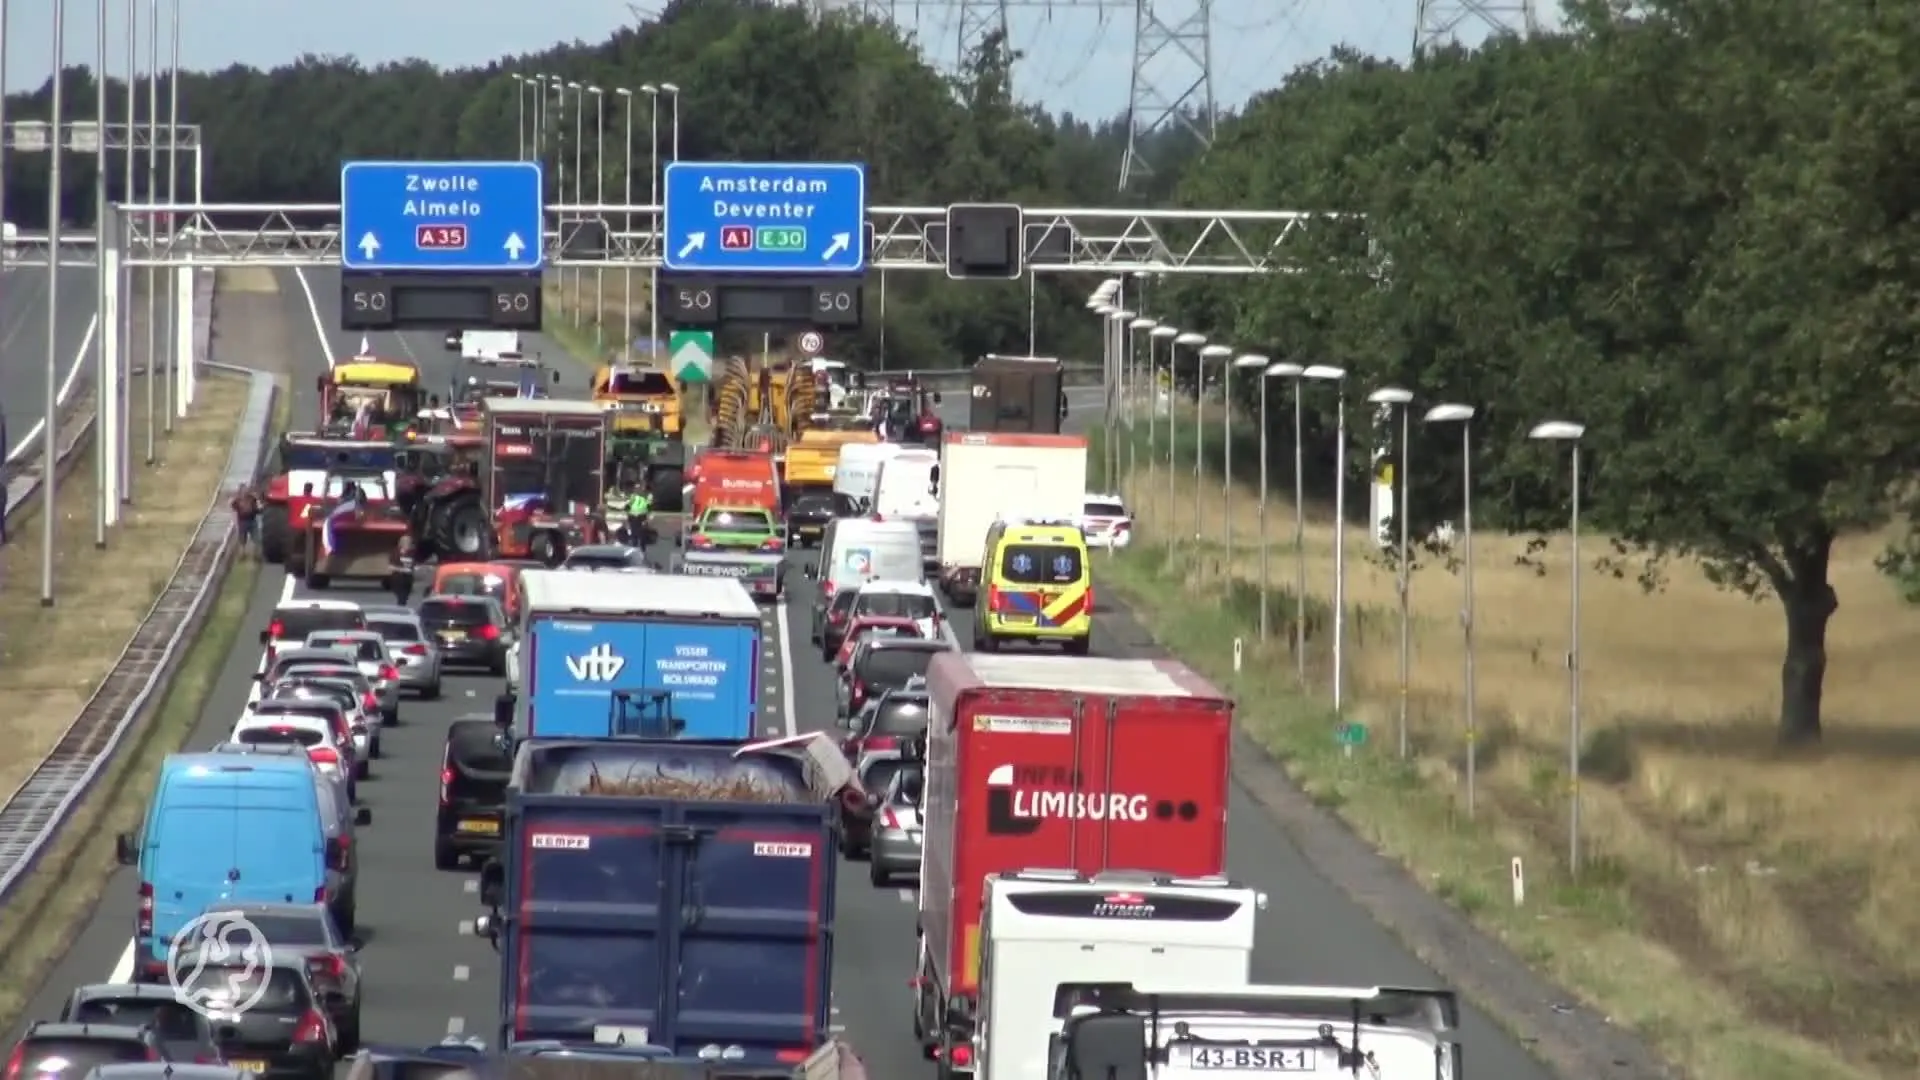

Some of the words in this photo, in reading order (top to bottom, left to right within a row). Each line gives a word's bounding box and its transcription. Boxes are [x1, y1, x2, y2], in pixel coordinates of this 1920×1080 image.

[405, 174, 479, 191] Zwolle
[700, 176, 827, 193] Amsterdam
[403, 200, 480, 216] Almelo
[714, 200, 815, 217] Deventer
[726, 231, 748, 246] A1
[354, 292, 386, 311] 50
[497, 293, 529, 312] 50
[680, 290, 712, 309] 50
[819, 292, 851, 311] 50
[675, 646, 708, 657] VISSER
[656, 659, 726, 673] TRANSPORTEN
[663, 674, 718, 685] BOLSWARD
[1013, 789, 1149, 821] LIMBURG
[1196, 1048, 1306, 1068] 43-BSR-1
